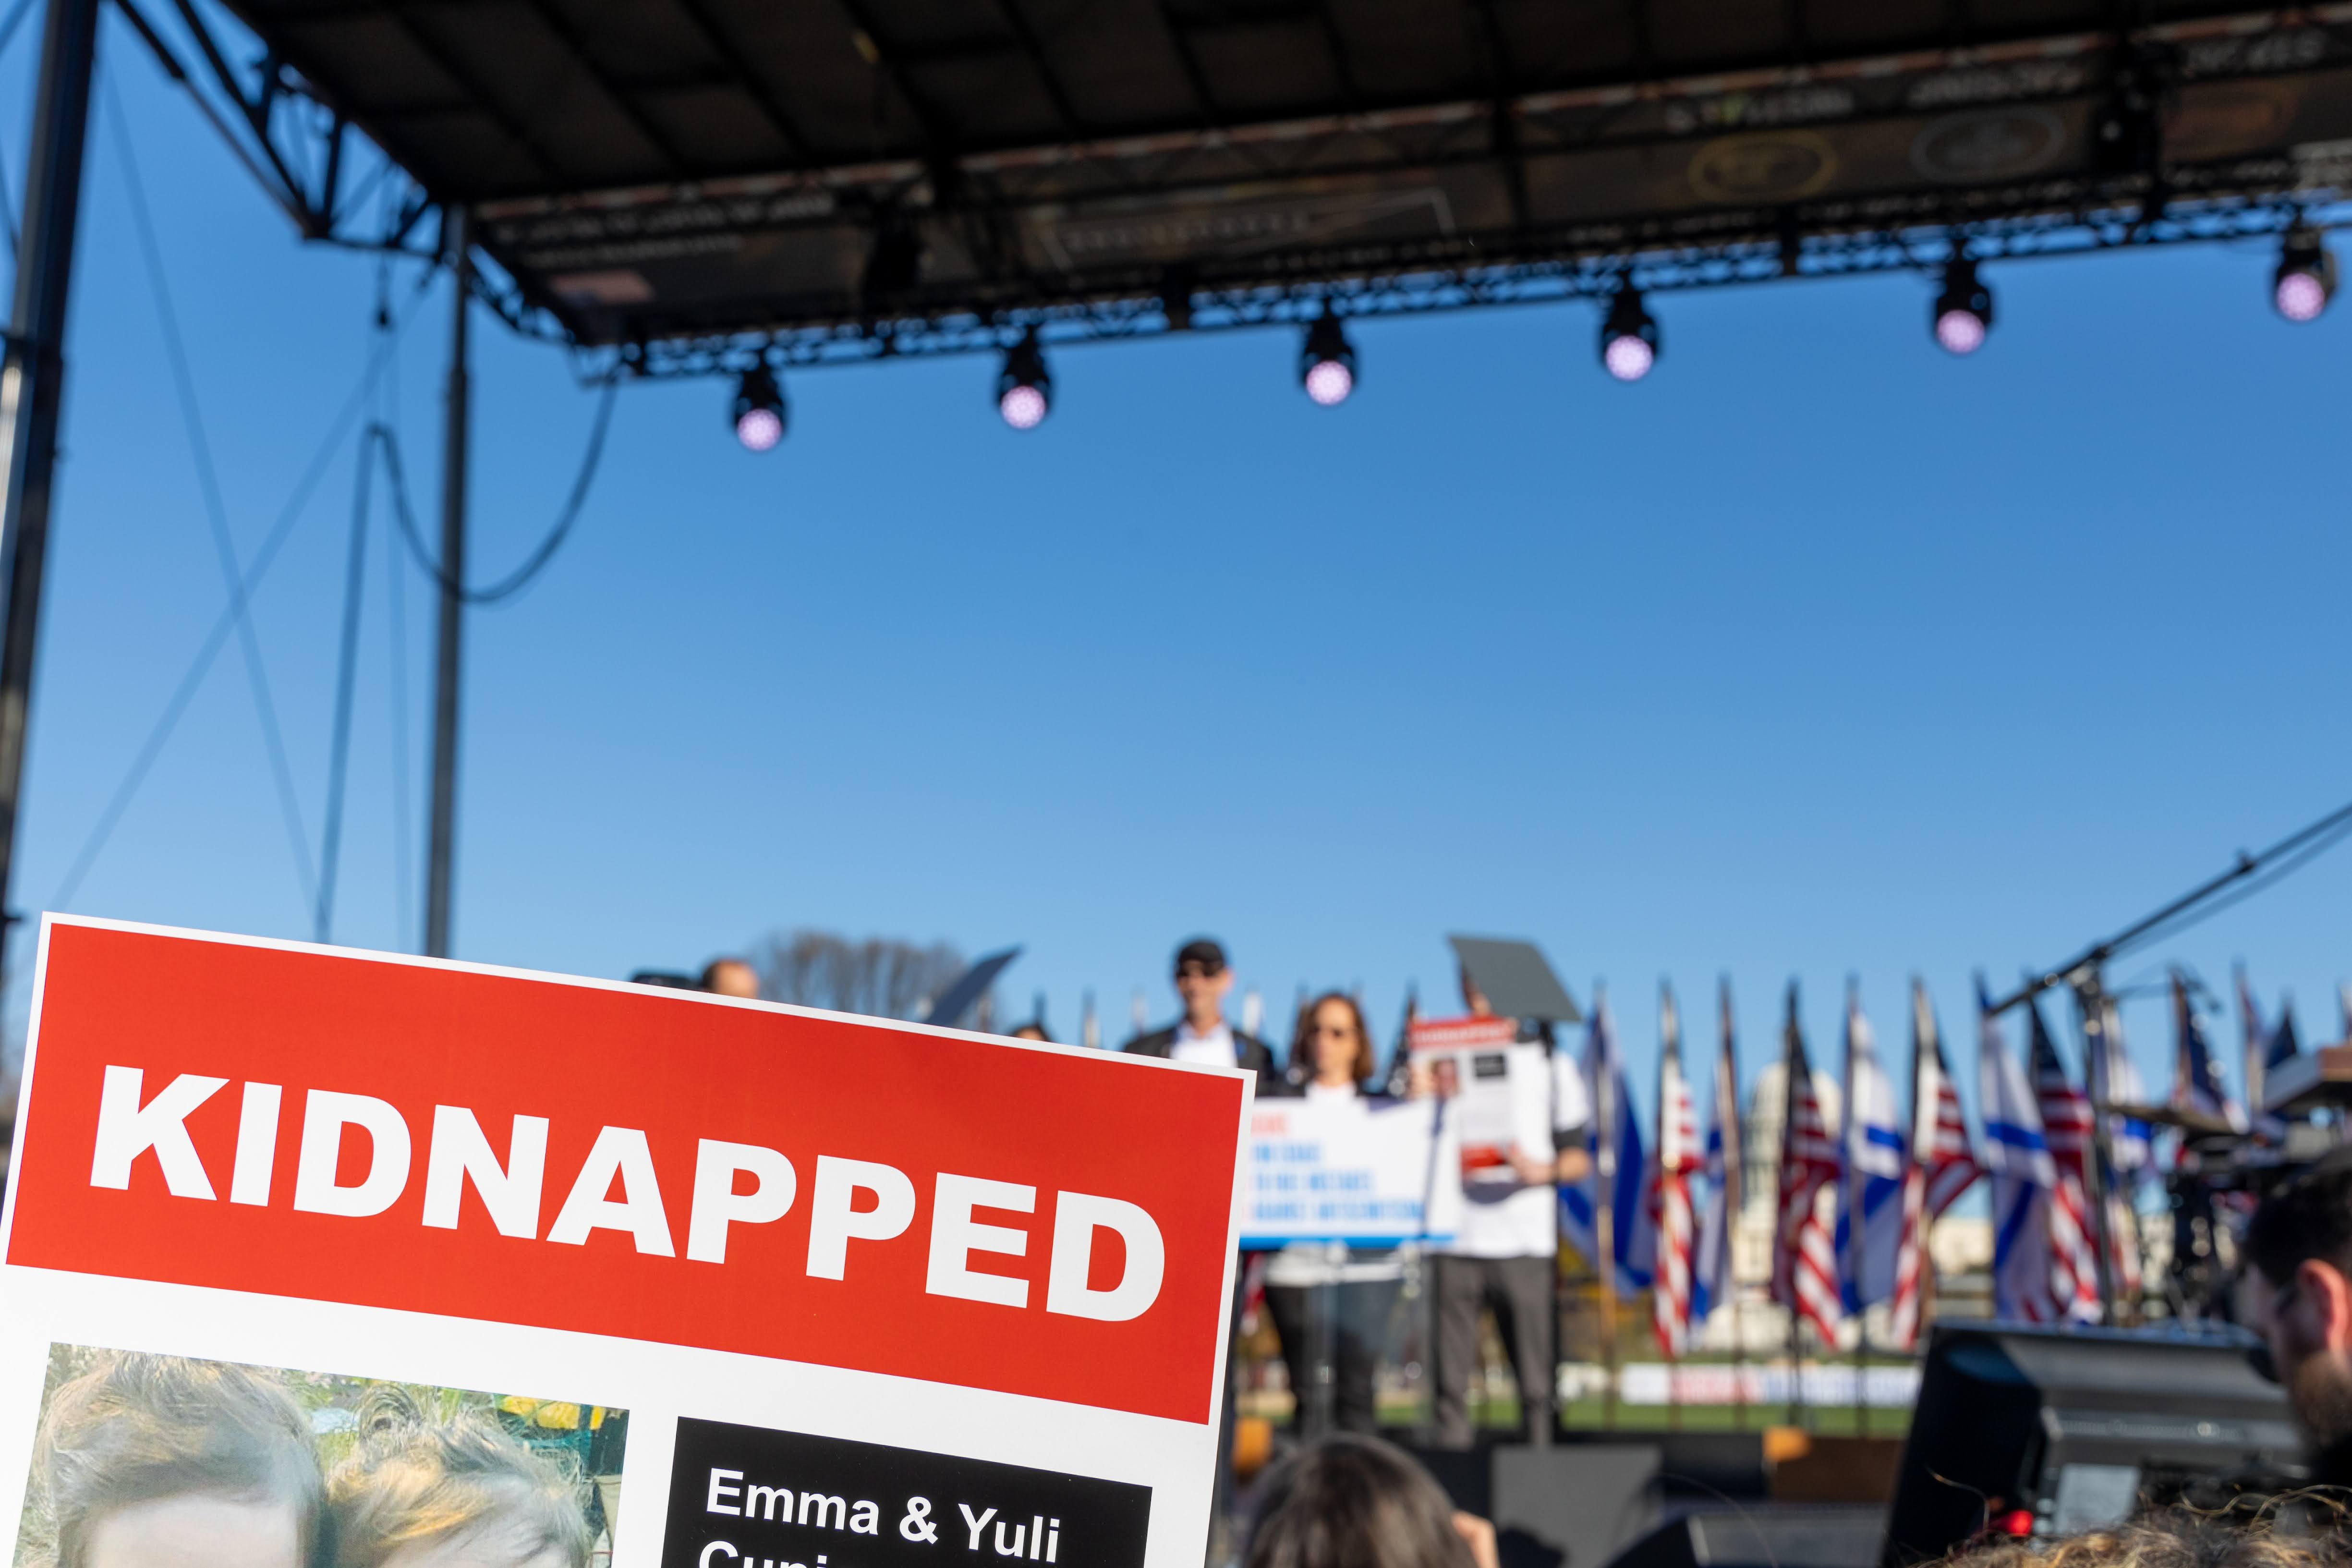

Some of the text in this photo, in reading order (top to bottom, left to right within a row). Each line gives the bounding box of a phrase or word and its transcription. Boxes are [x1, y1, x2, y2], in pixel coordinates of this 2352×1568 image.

[90, 1065, 1164, 1322] KIDNAPPED
[706, 1468, 1060, 1563] Emma & Yuli
